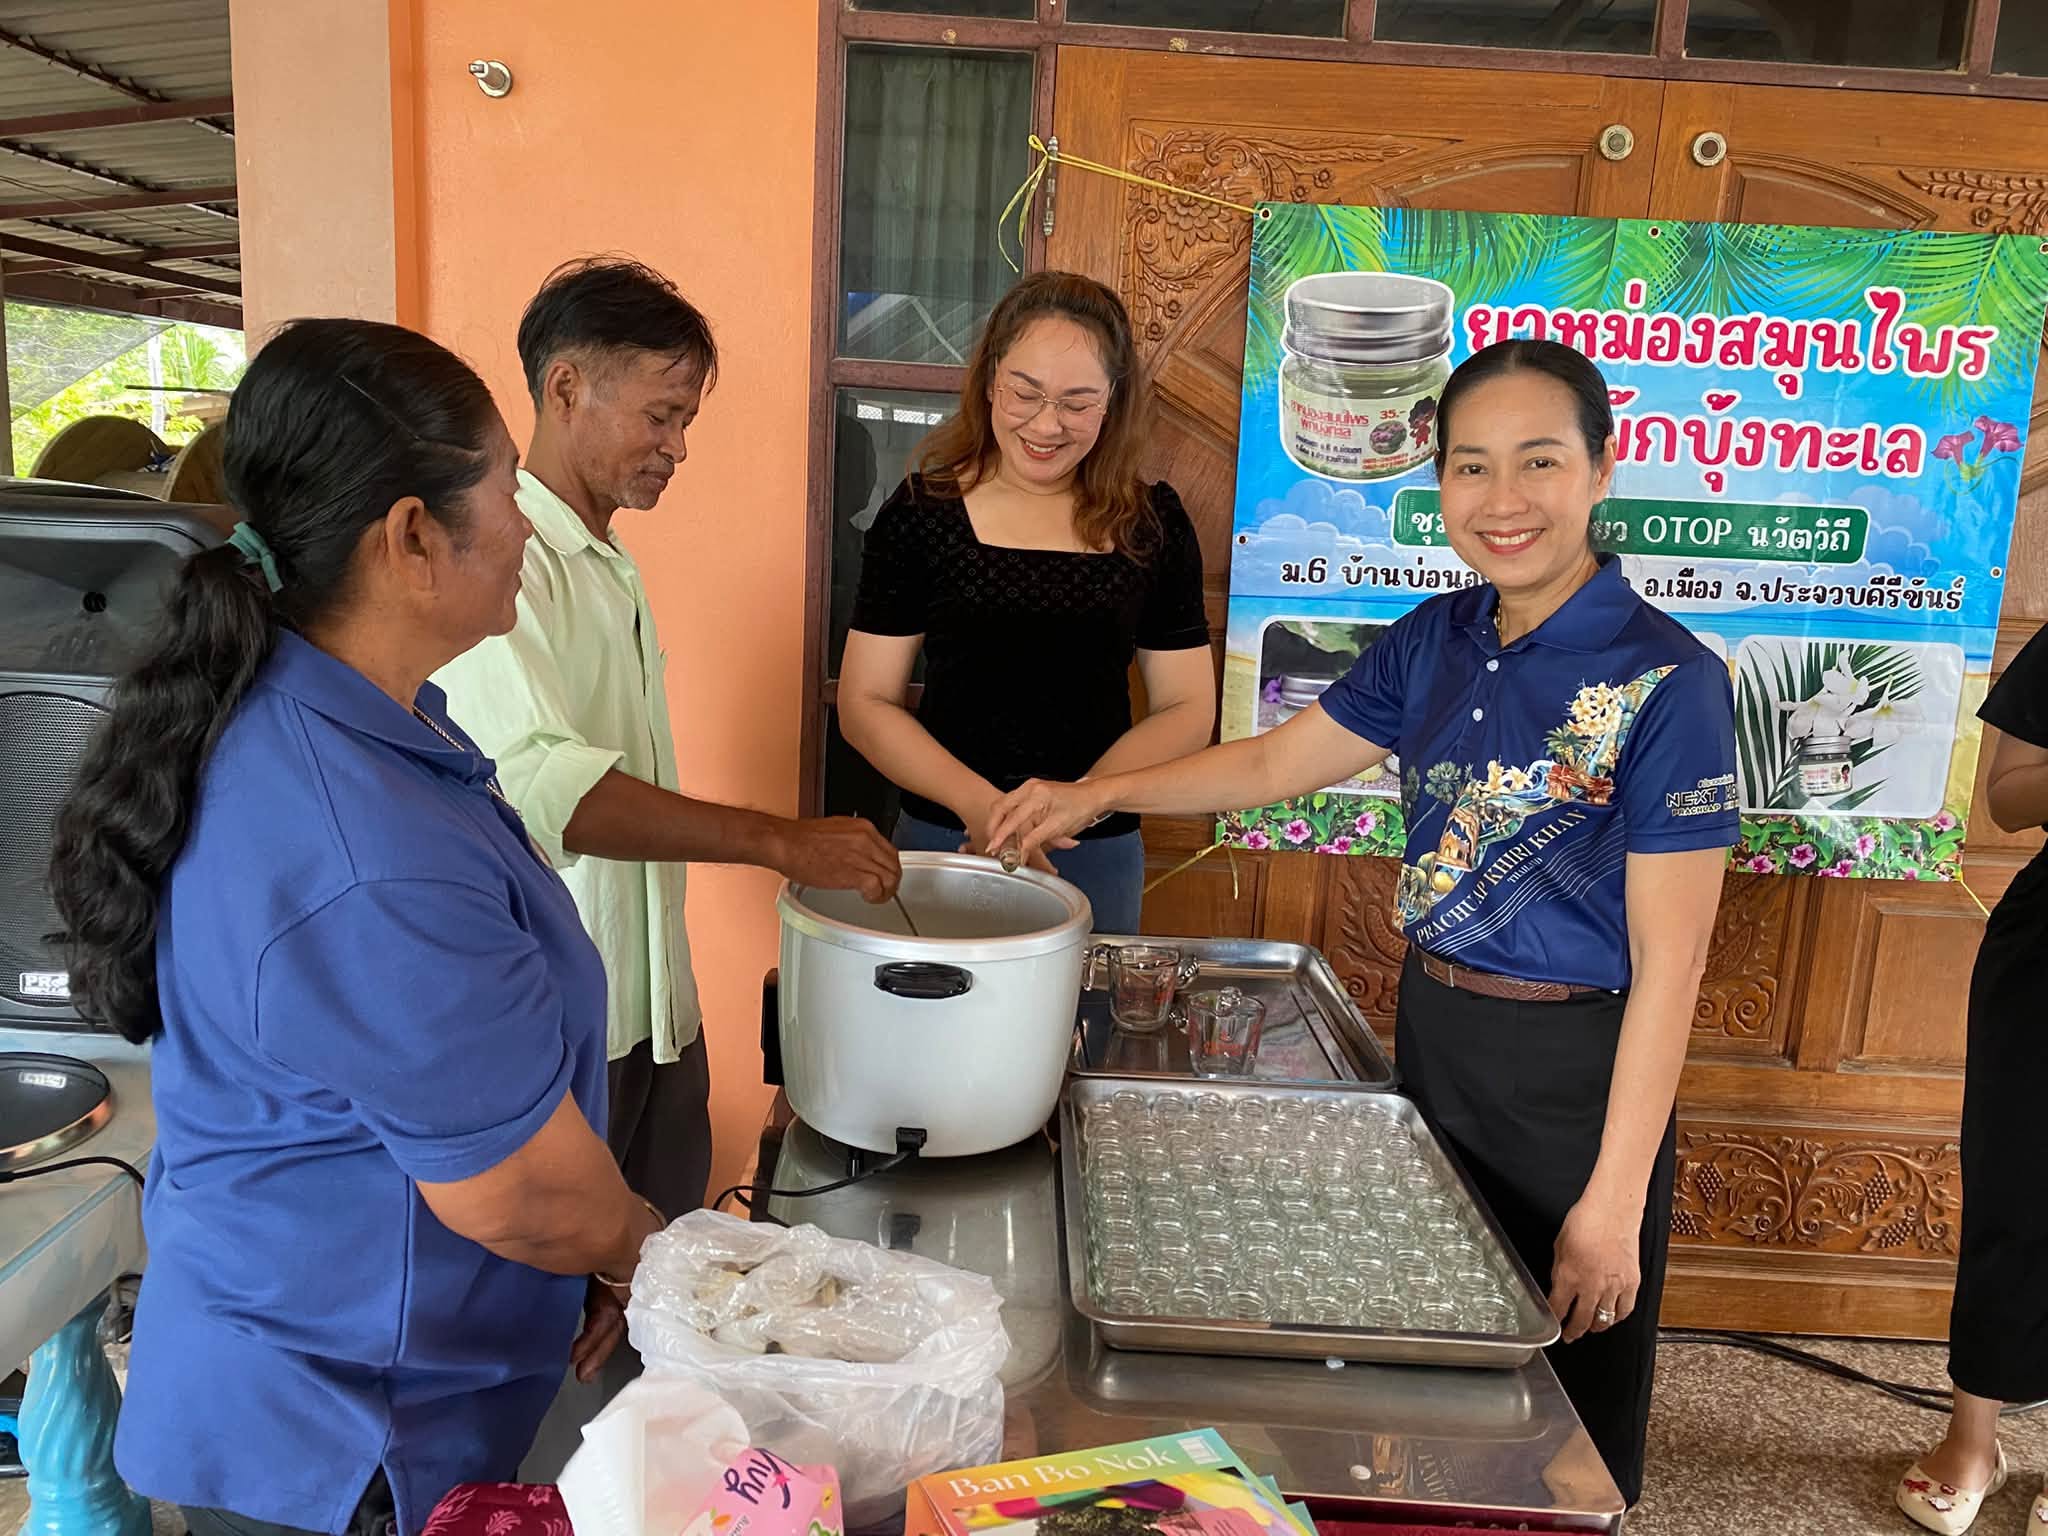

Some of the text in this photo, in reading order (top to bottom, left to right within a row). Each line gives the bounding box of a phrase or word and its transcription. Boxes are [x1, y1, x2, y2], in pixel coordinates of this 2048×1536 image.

[1643, 515, 1733, 546] OTOP
[1748, 516, 1851, 551] นวัตวิถี
[1281, 558, 1327, 584] ม.6
[1341, 555, 1491, 589] บ้านบ่อนอ
[1645, 568, 1722, 600] อ.เมือง
[1666, 787, 1718, 808] NEXT
[1672, 803, 1721, 817] PRACHUAP
[1416, 809, 1587, 944] PRACHUAP KHIRI KHAN
[948, 1445, 1177, 1498] Ban Bo Nok
